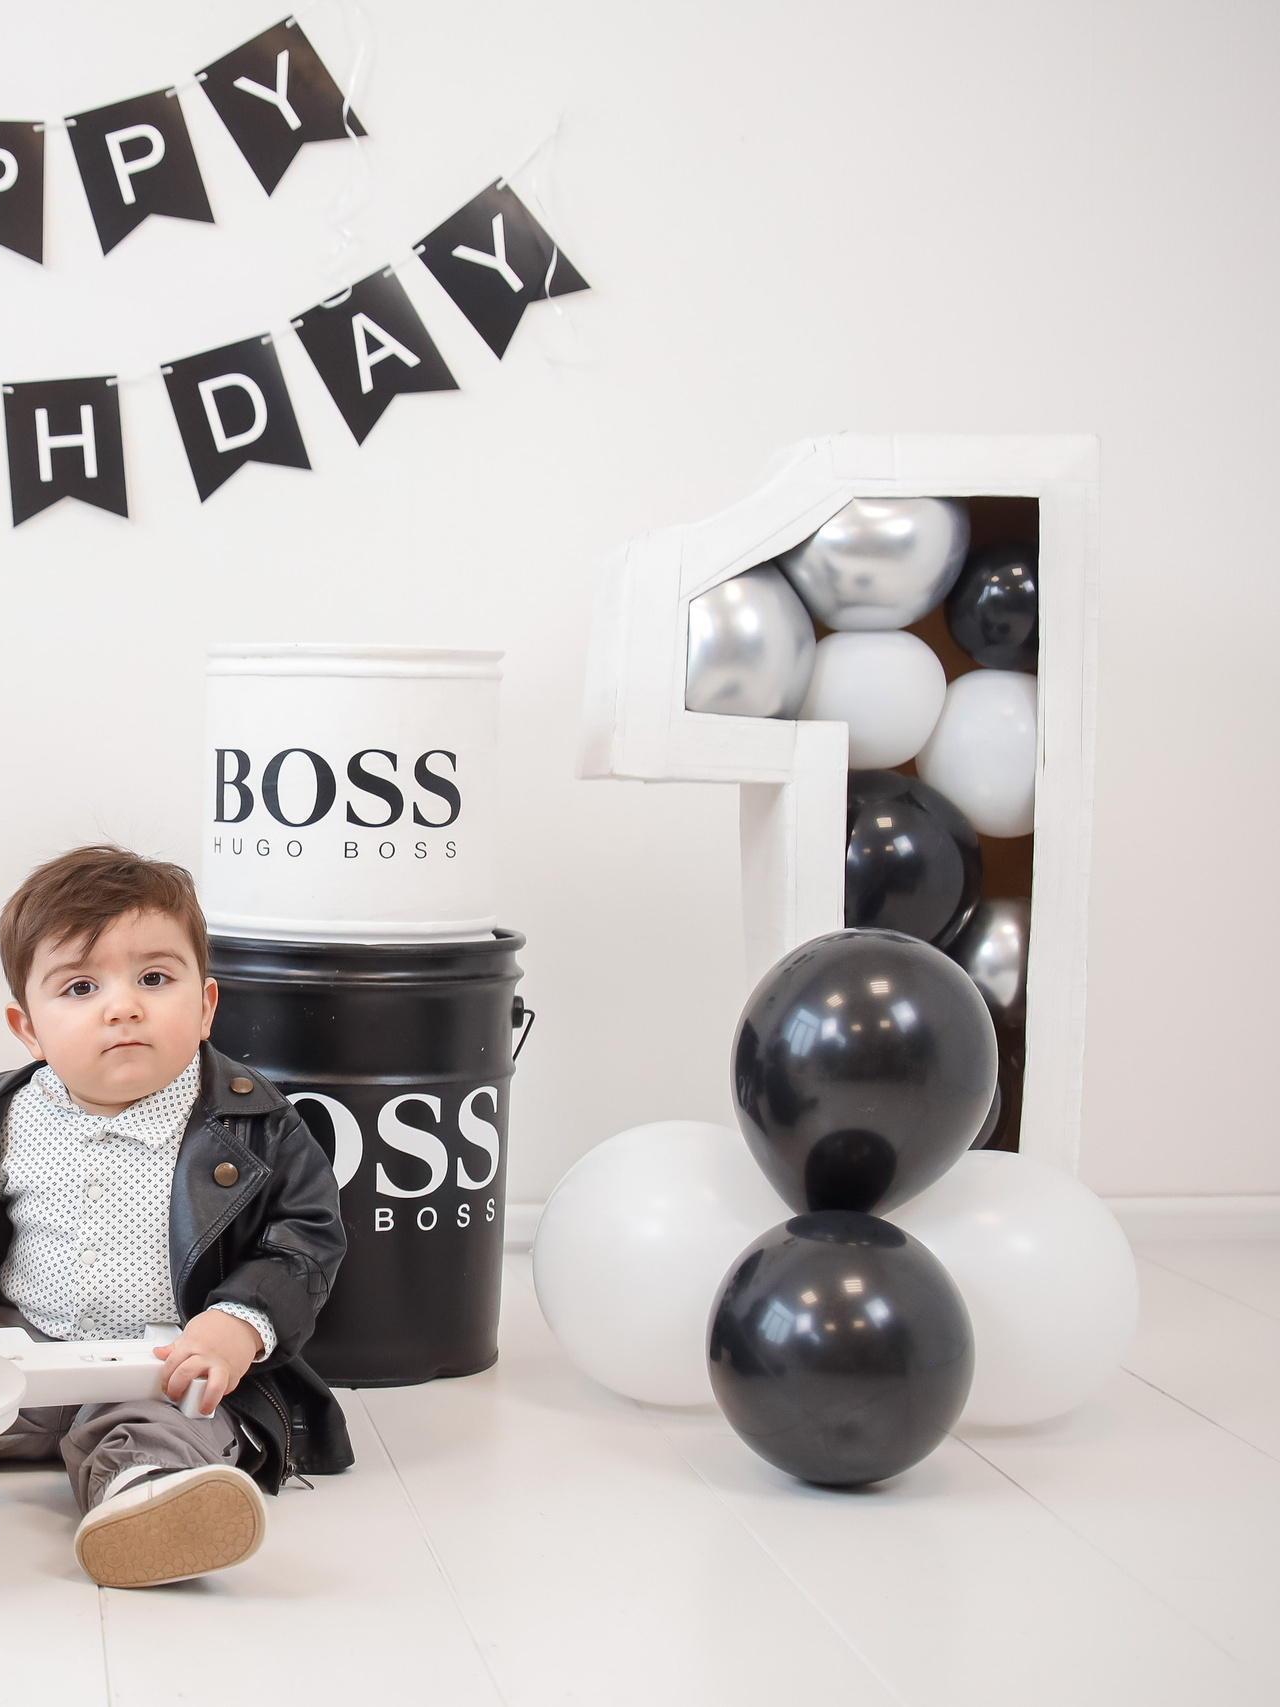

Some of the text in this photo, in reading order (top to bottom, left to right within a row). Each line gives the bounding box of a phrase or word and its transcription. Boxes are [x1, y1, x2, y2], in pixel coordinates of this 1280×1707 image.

[212, 747, 463, 828] BOSS
[212, 836, 459, 860] HUGO BOSS
[286, 1085, 501, 1199] OSS
[373, 1197, 497, 1233] BOSS
